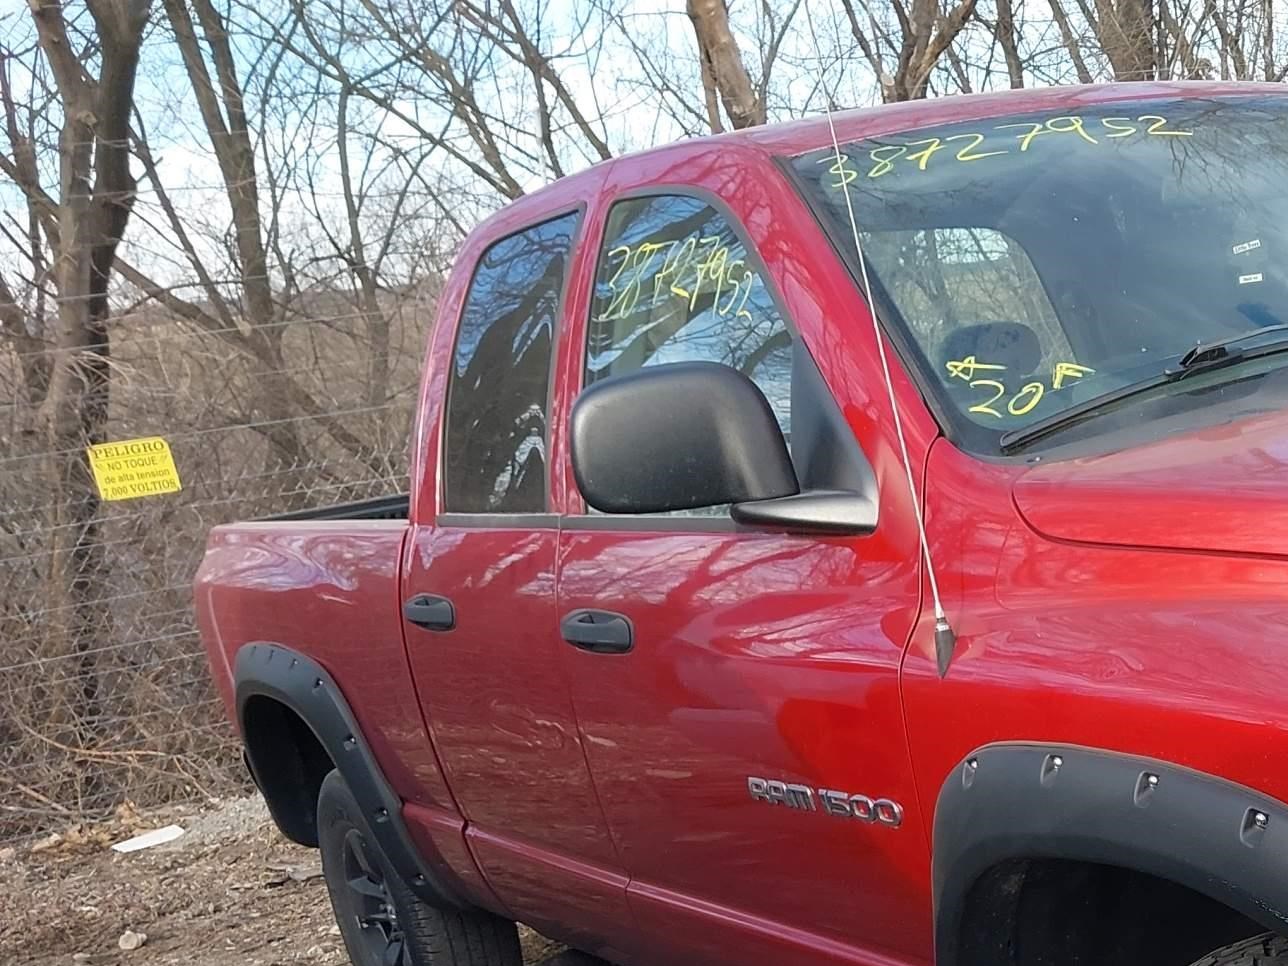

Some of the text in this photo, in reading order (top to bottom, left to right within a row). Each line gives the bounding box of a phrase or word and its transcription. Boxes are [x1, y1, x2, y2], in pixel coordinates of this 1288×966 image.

[816, 115, 1194, 188] 38727952
[94, 441, 164, 458] PELIGRO
[107, 456, 158, 471] NO TOQUE
[130, 478, 177, 492] VOLTIOS
[747, 776, 904, 829] RAM 1500
